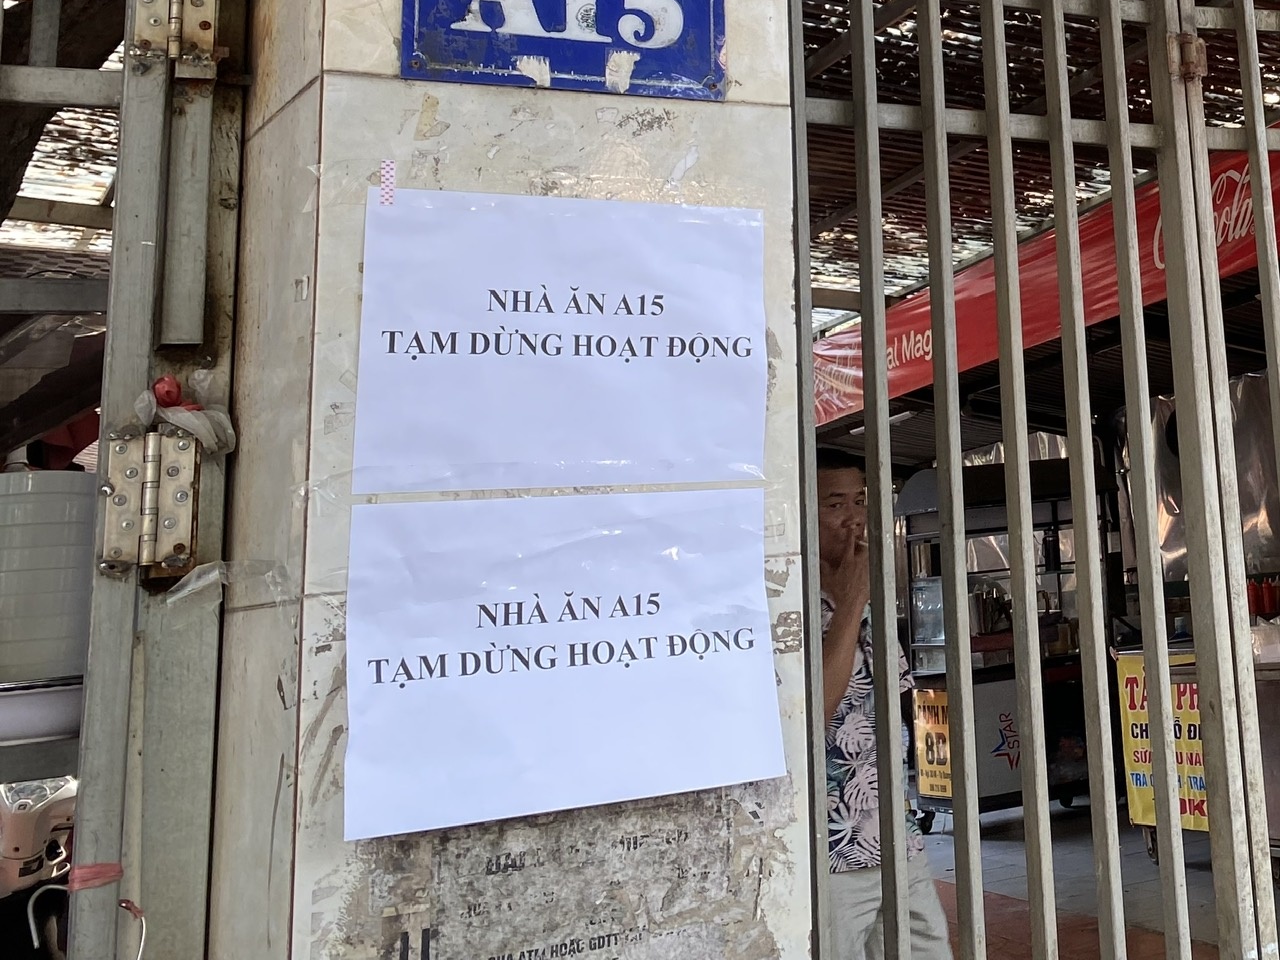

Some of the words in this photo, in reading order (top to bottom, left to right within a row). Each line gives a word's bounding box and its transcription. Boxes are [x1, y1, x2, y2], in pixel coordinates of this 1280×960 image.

[486, 284, 554, 314] NHÀ
[564, 286, 606, 315] ĂN
[613, 294, 665, 316] A15
[381, 330, 458, 361] TẠM
[469, 325, 562, 356] DỪNG
[573, 334, 658, 363] HOẠT
[667, 331, 752, 363] ĐỘNG
[476, 593, 547, 628] NHÀ
[557, 591, 601, 622] ĂN
[608, 592, 661, 618] A15
[367, 654, 448, 689] TẠM
[458, 641, 557, 676] DỪNG
[567, 637, 658, 669] HOẠT
[667, 627, 755, 661] ĐỘNG
